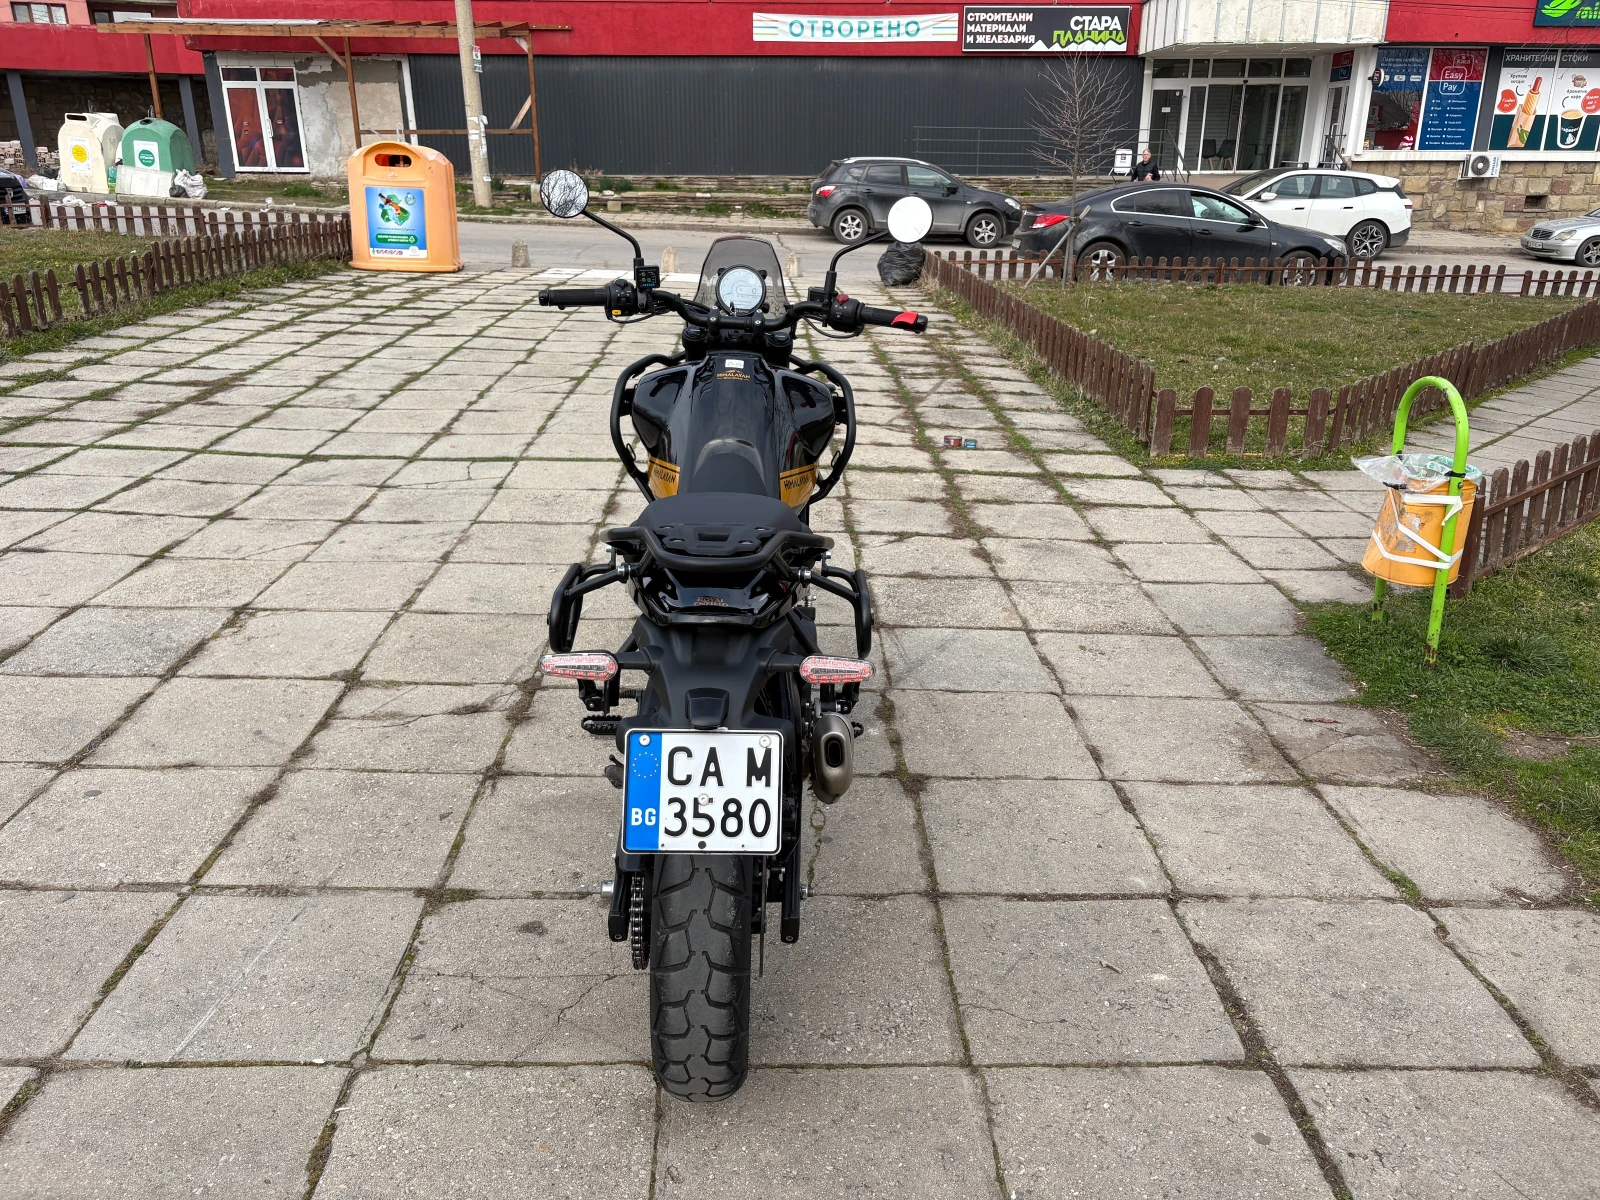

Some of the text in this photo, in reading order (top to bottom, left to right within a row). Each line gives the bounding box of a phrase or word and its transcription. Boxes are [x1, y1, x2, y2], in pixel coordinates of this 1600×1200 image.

[967, 12, 1034, 23] СТРОИТЕЛНИ
[1069, 15, 1123, 31] СТАРА
[788, 19, 921, 38] ОТВОРЕНО
[966, 24, 1027, 33] МАТЕРИАЛИ
[966, 35, 1036, 45] И ЖЕЛЕЗАРИЯ
[1052, 30, 1126, 47] ПЛАНИНА
[1504, 54, 1590, 62] ХРАНИТЕЛНИ СТОКИ
[1445, 71, 1464, 80] Easy
[1443, 83, 1458, 92] Pay
[746, 746, 773, 788] M
[630, 807, 657, 826] BG
[663, 796, 773, 838] 3580
